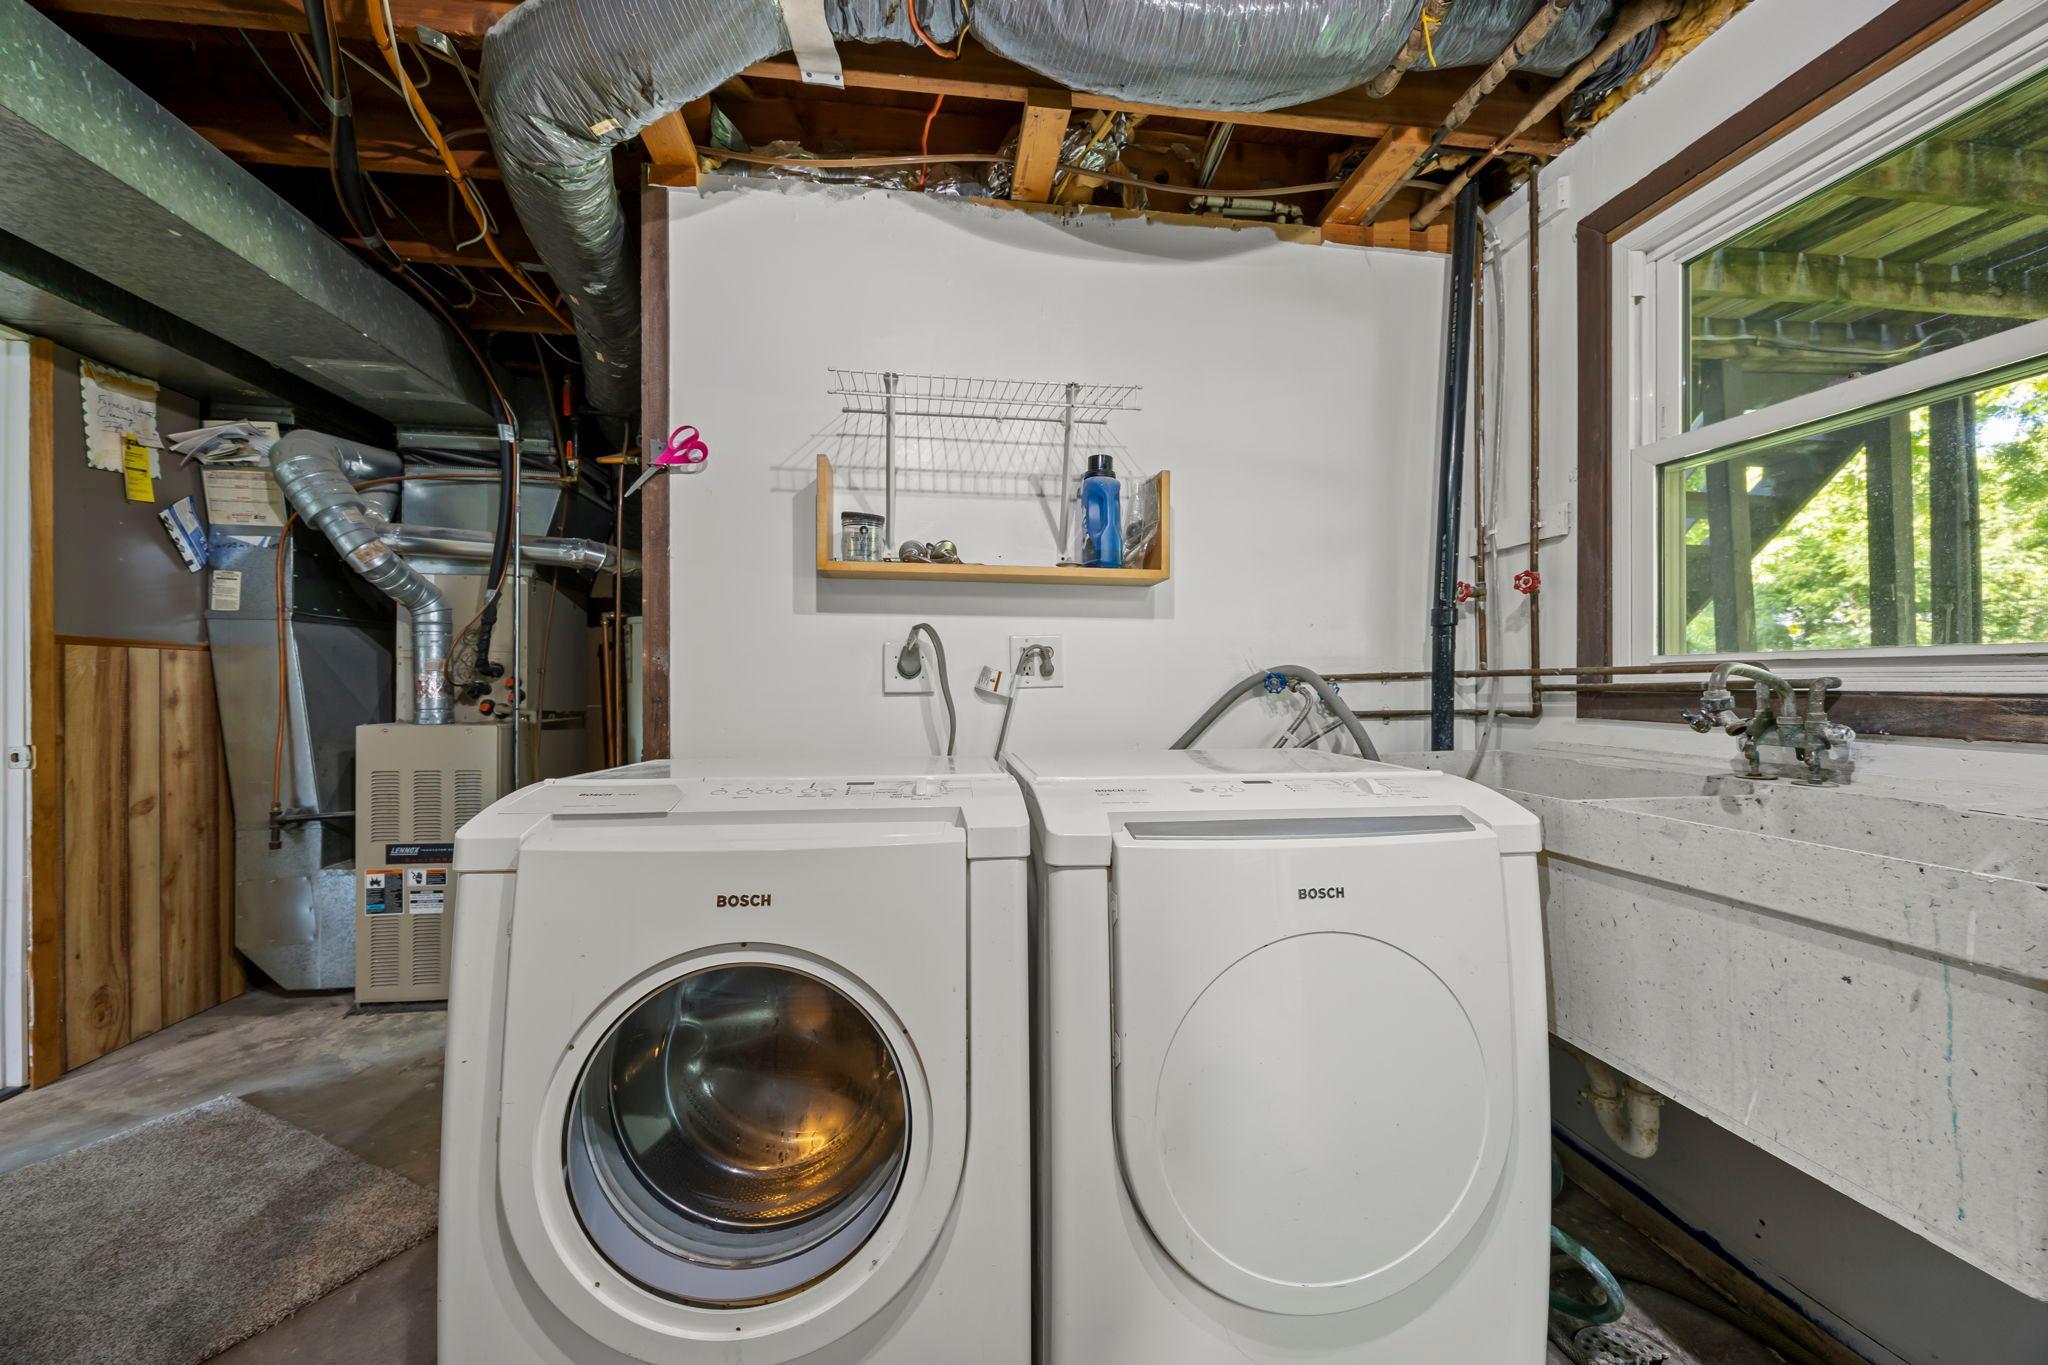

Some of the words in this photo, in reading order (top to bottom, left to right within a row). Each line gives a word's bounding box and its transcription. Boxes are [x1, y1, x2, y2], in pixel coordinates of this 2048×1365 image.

[390, 847, 420, 855] LENNOX
[1297, 887, 1345, 899] BOSCH
[716, 894, 772, 907] BOSCH
